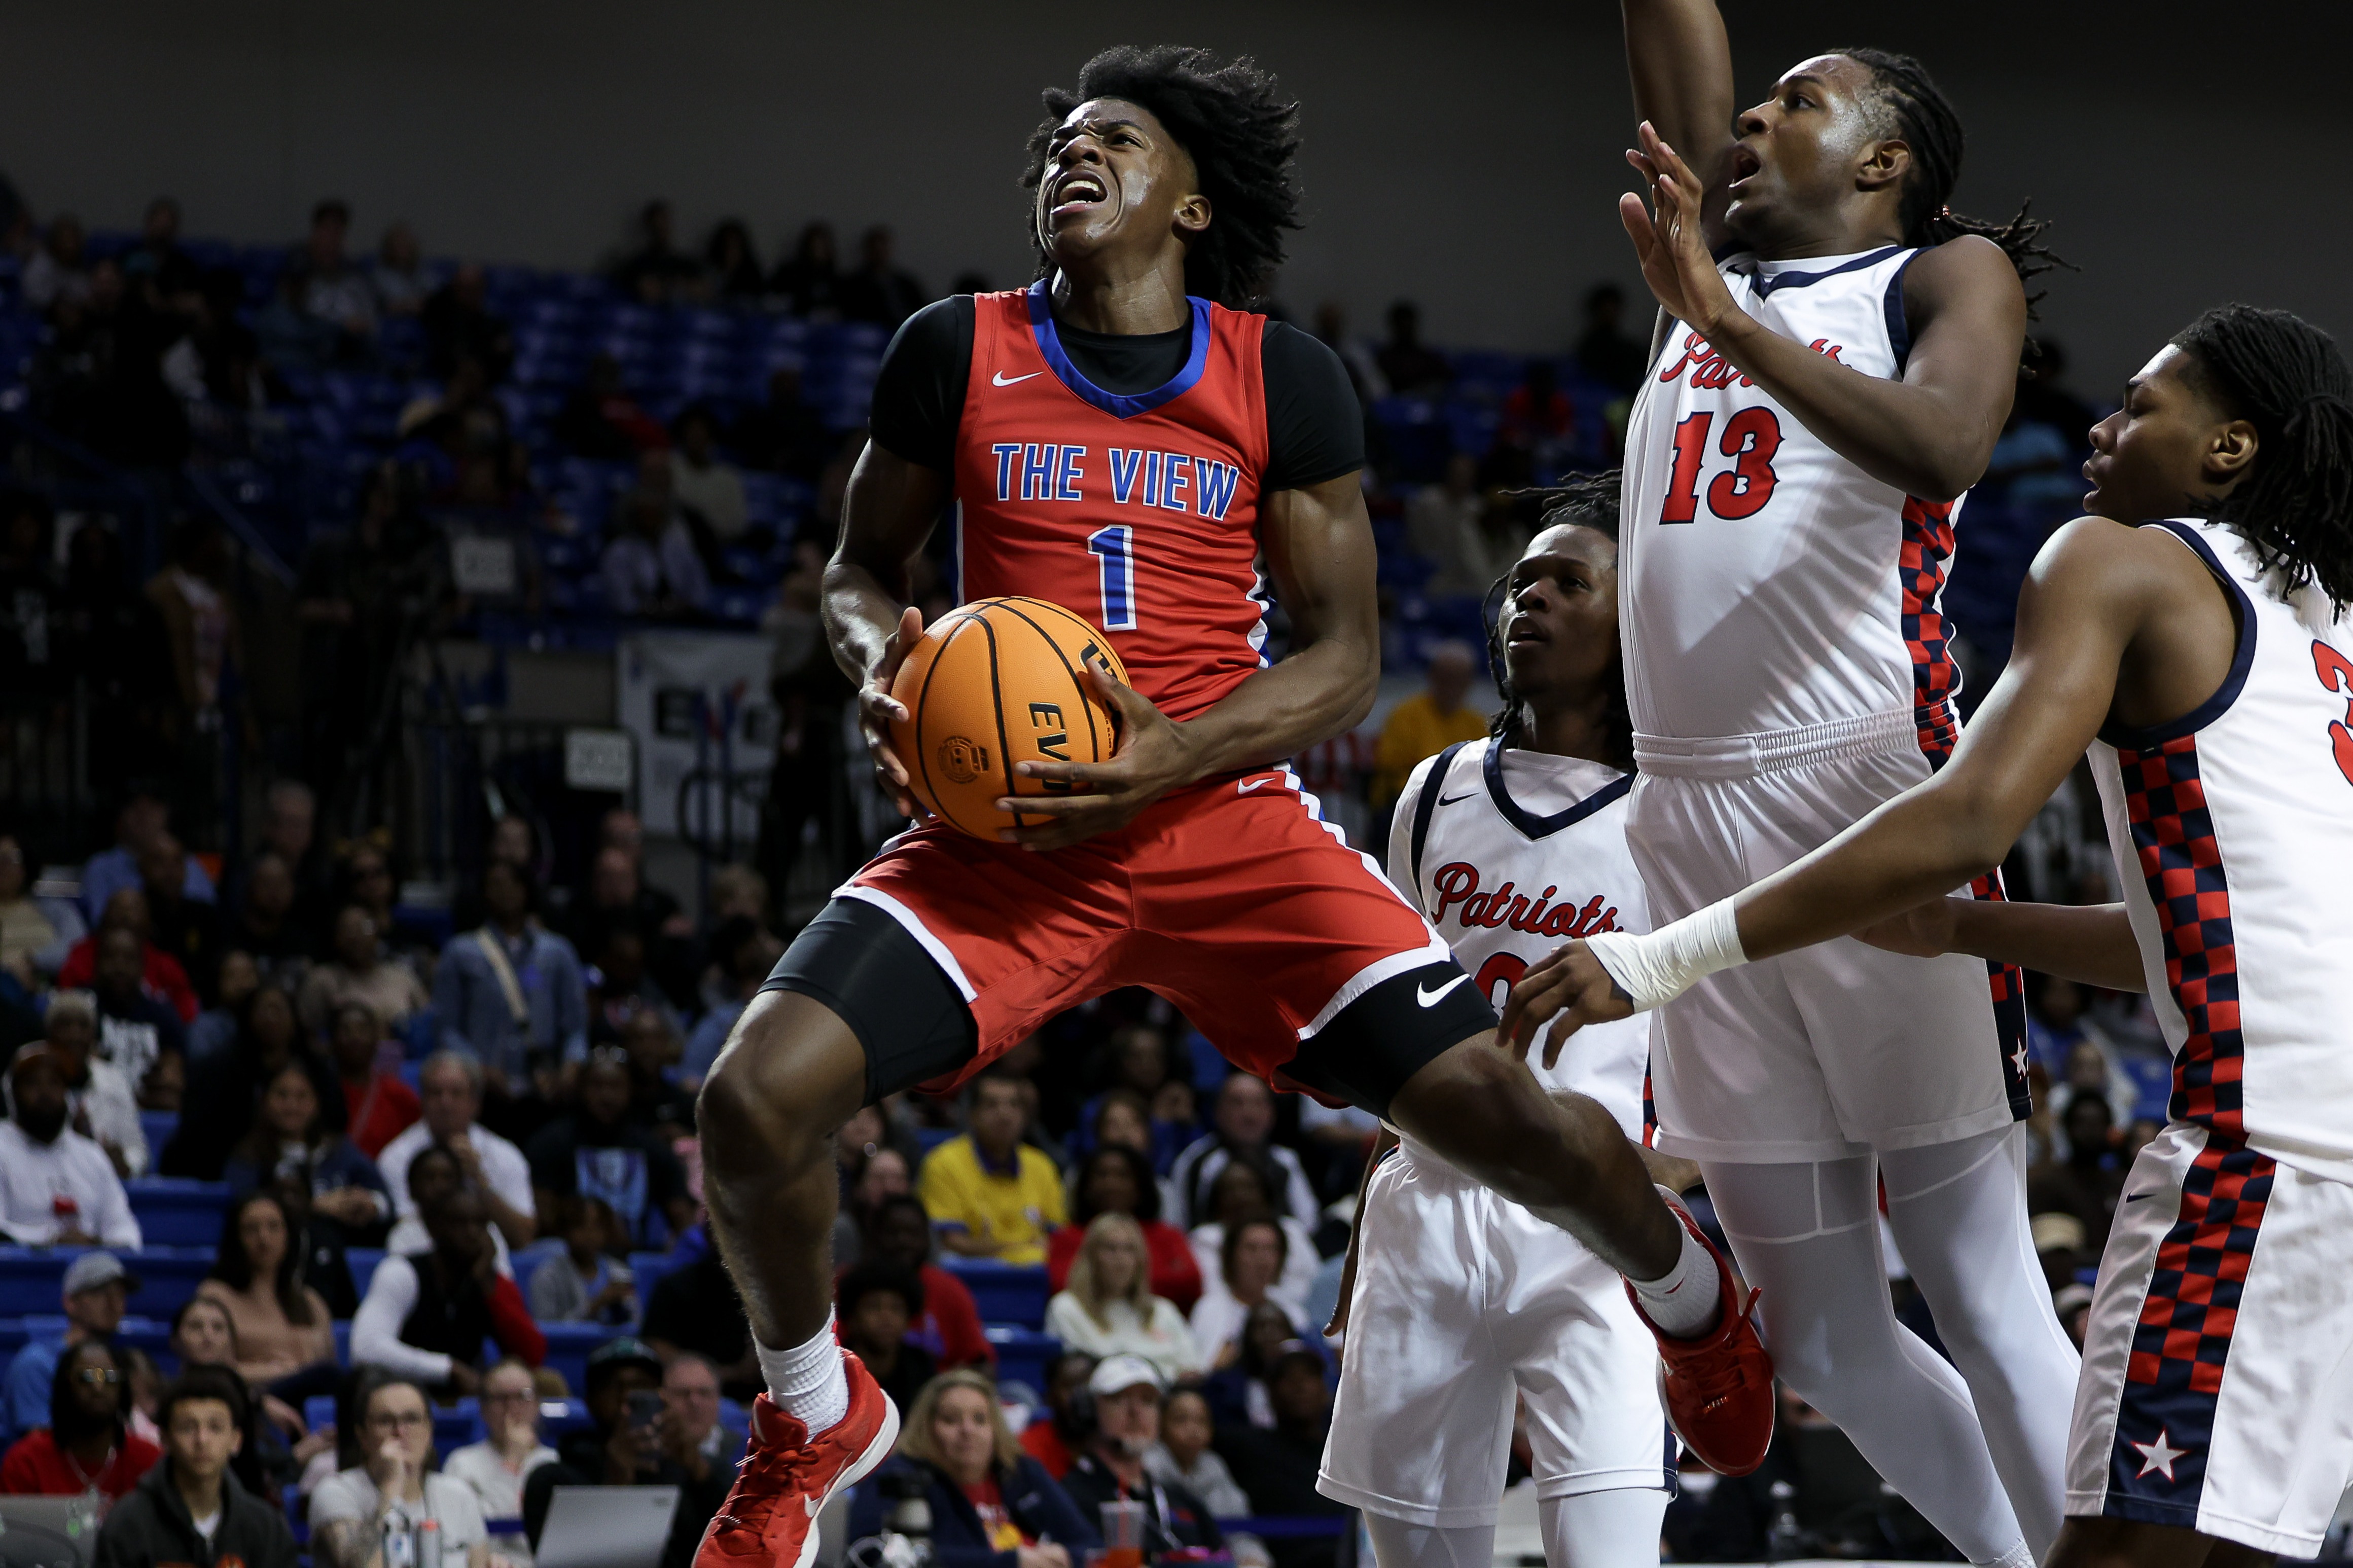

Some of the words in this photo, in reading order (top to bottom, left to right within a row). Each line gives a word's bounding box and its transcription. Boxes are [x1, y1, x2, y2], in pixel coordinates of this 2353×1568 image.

[992, 443, 1087, 501] THE
[1108, 448, 1239, 521] VIEW
[1659, 406, 1786, 525] 13
[1087, 524, 1137, 632] 1
[1431, 862, 1623, 938] Patriots
